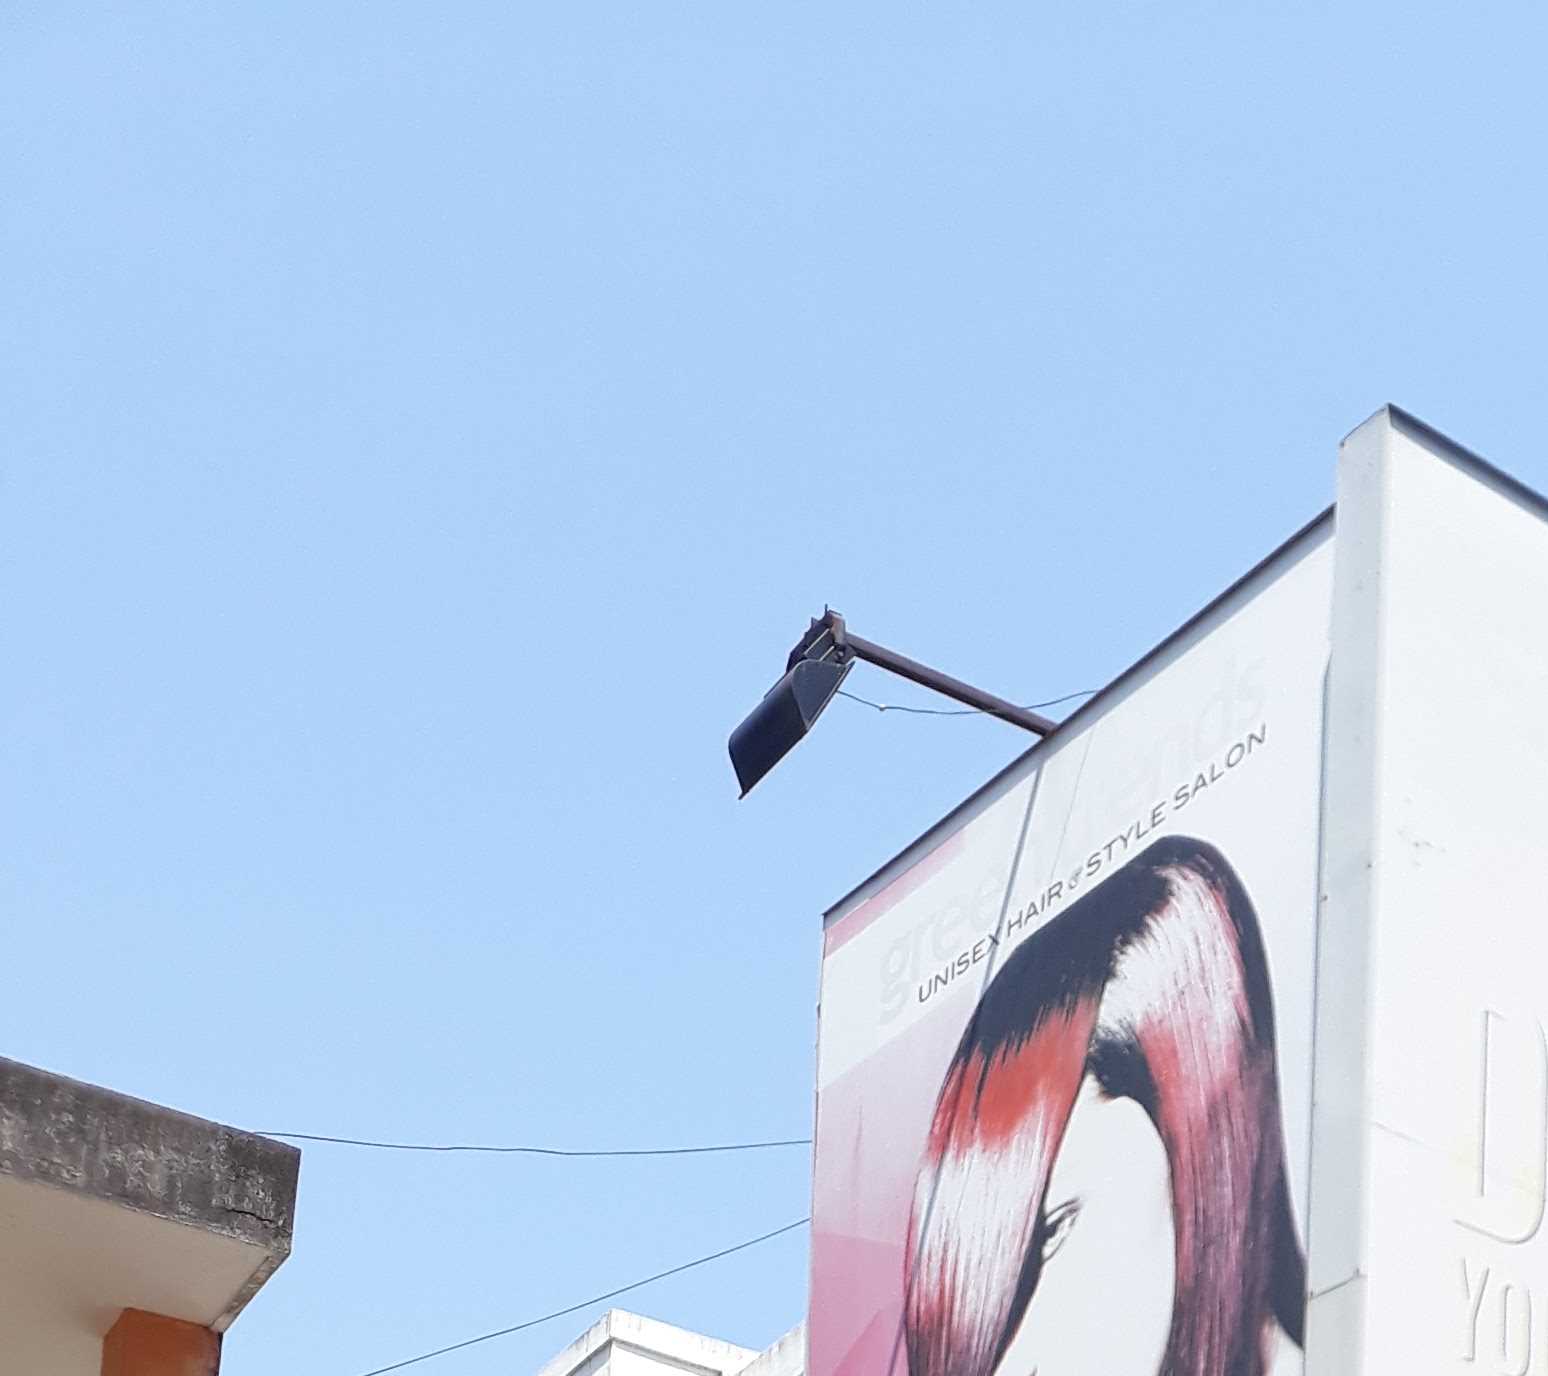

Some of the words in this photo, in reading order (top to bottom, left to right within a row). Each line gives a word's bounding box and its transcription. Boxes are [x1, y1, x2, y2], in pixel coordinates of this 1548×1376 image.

[917, 931, 1001, 1004] UNISEX
[1006, 880, 1064, 938] HAIR
[1067, 865, 1084, 890] &
[1085, 801, 1167, 878] STYLE
[1172, 723, 1267, 811] SALON
